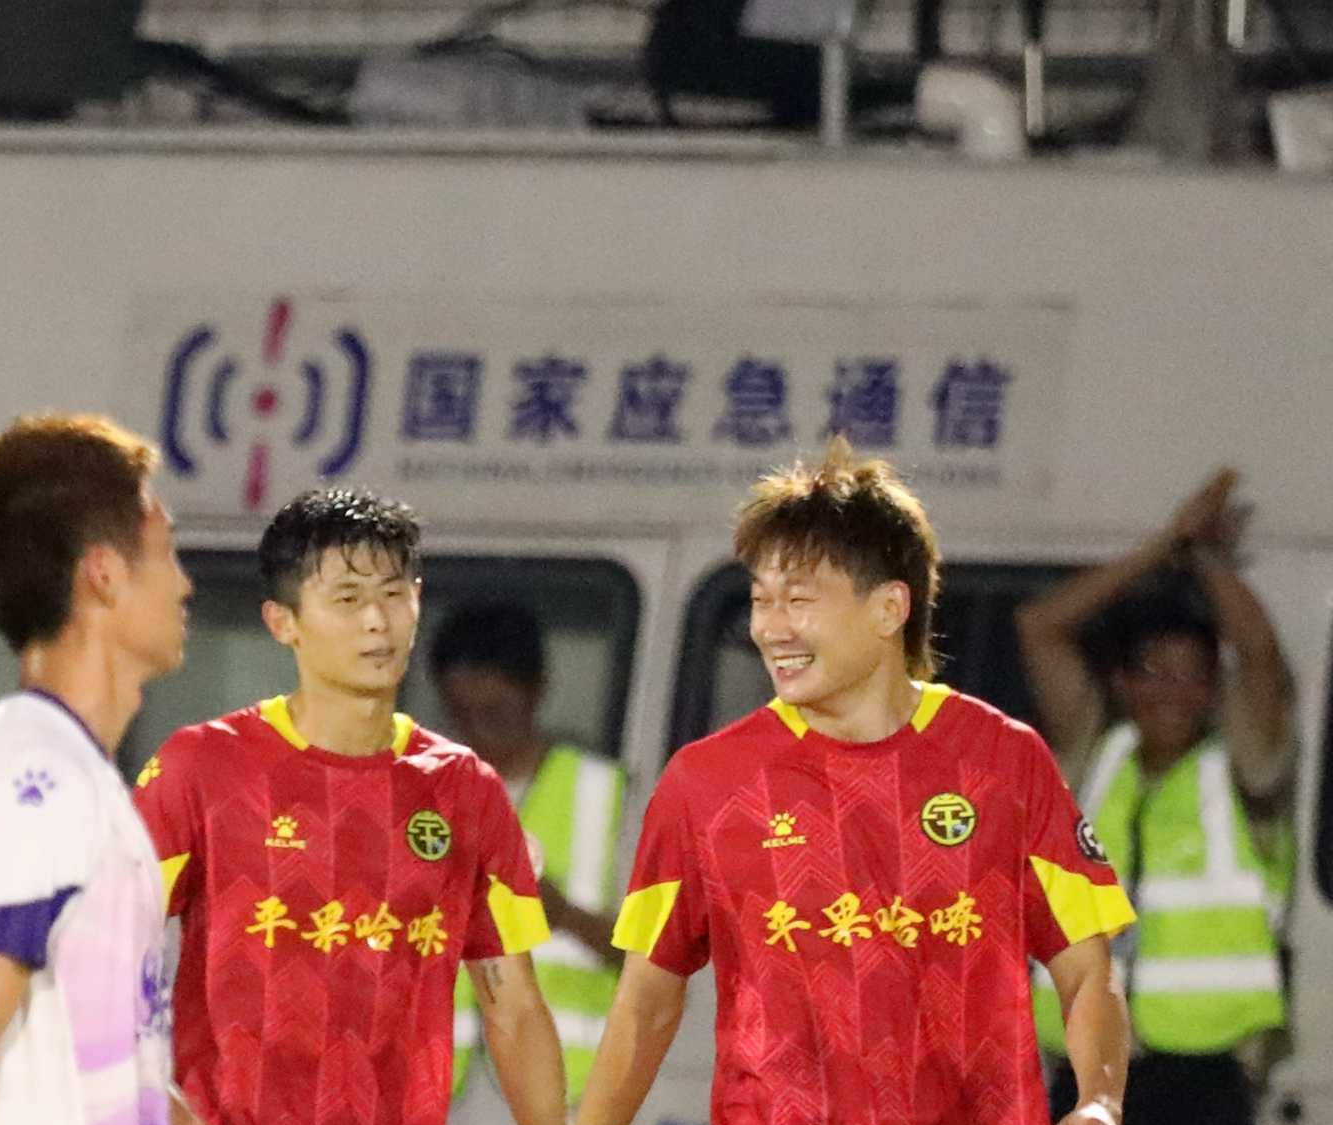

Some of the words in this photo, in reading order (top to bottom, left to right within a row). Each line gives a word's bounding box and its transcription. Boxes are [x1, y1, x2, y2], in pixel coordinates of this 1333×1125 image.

[398, 352, 1013, 450] 国家应急通信
